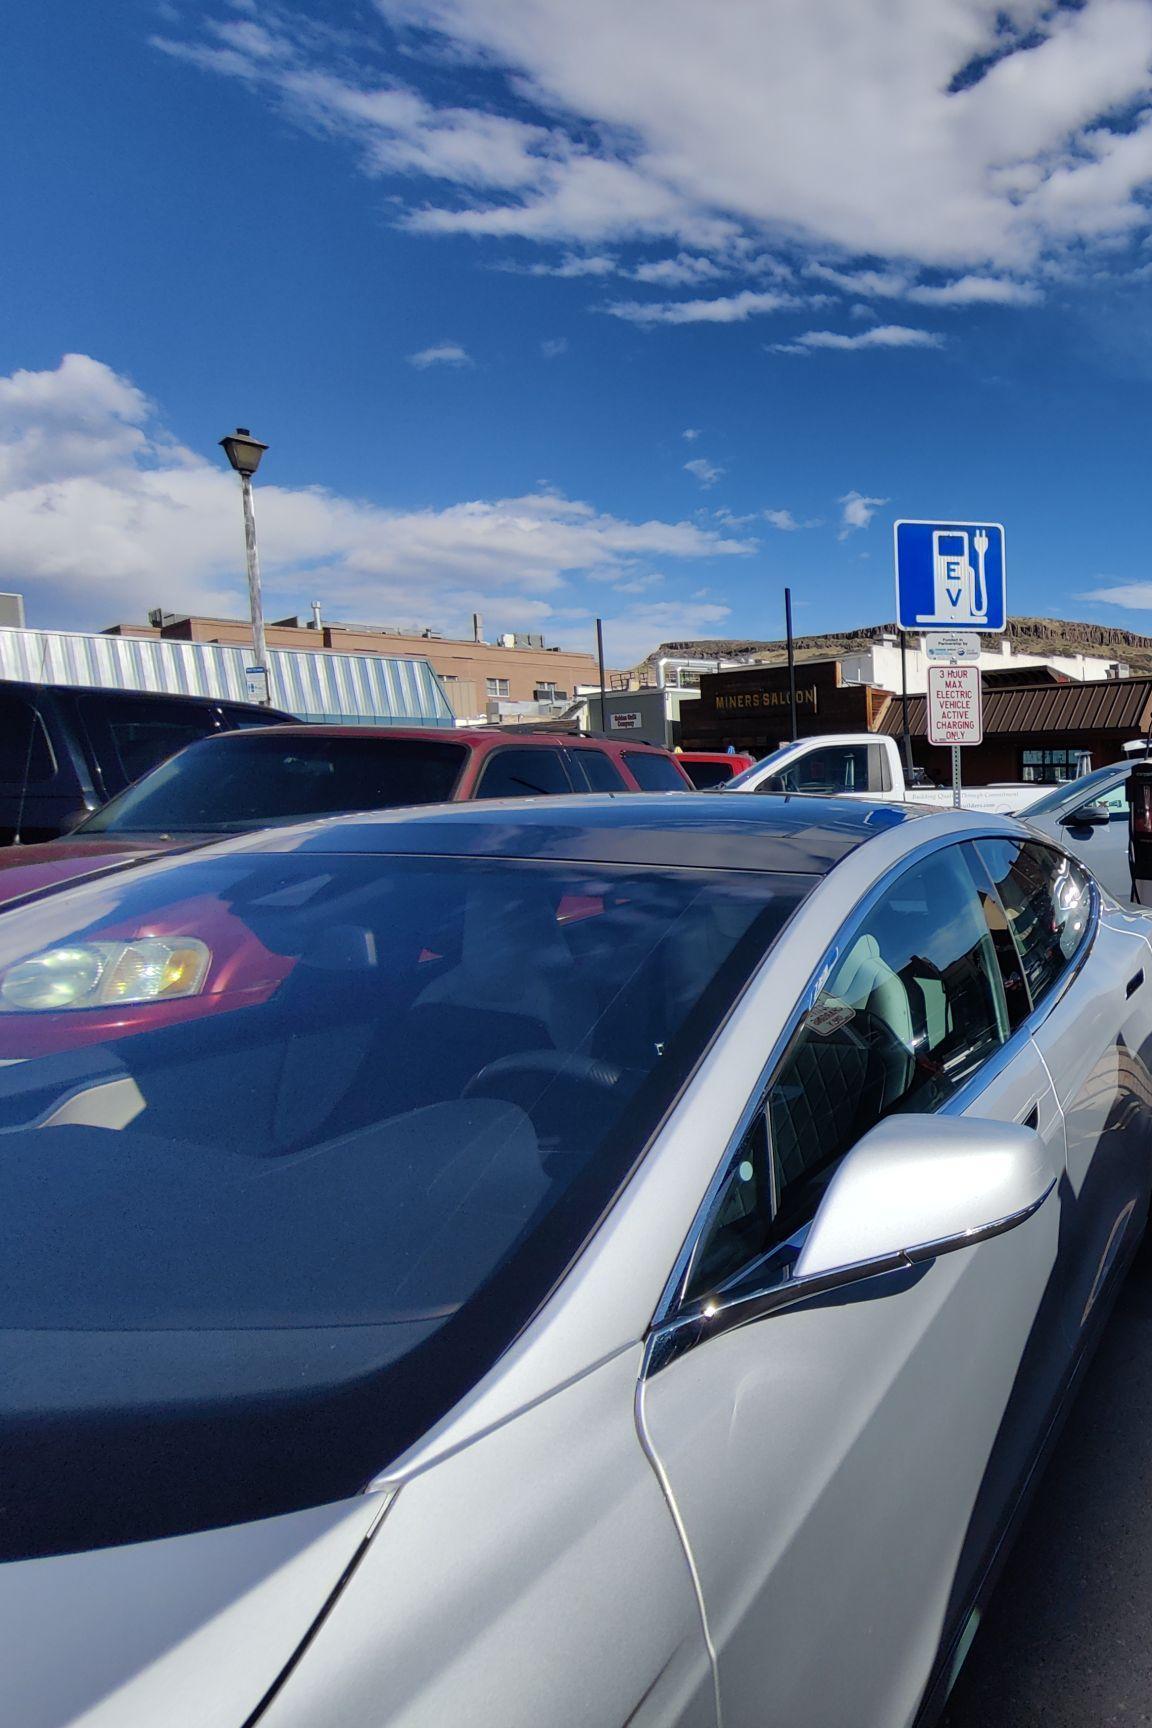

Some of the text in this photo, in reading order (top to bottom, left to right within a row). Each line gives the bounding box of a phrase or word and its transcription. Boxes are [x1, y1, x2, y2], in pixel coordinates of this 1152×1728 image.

[940, 670, 968, 678] 3 HOUR
[936, 690, 973, 699] ELECTRIC
[716, 694, 760, 709] MINERS
[939, 700, 970, 709] VEHICLE
[941, 711, 969, 719] ACTIVE
[936, 721, 975, 729] CHARGING
[946, 731, 965, 740] ONLY
